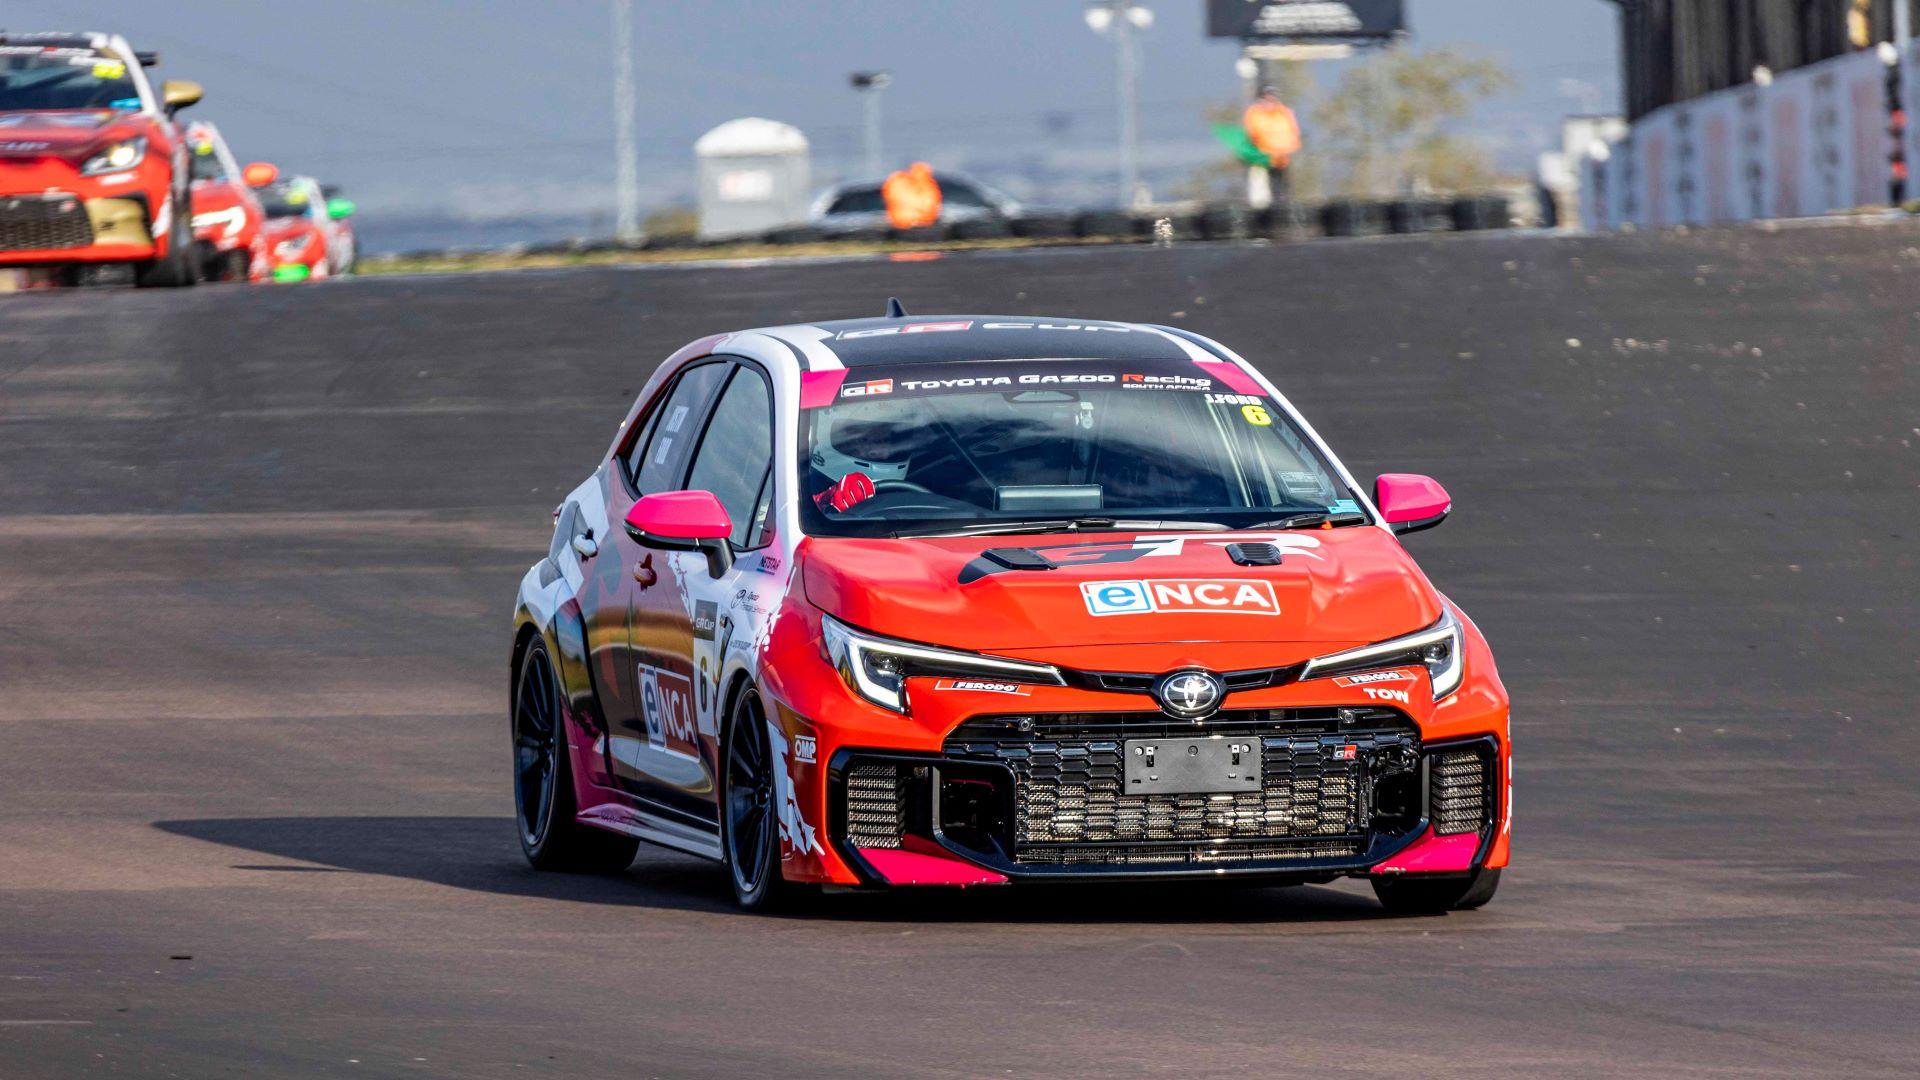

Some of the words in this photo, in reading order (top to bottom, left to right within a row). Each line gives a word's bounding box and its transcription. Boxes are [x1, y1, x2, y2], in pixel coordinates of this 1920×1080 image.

[842, 380, 892, 396] GR
[901, 376, 1012, 390] TOYOTA
[1019, 374, 1116, 384] GAZOO
[1122, 374, 1211, 387] Racing
[1241, 405, 1272, 426] 6
[700, 656, 708, 713] 6
[956, 682, 1016, 692] FERODO
[1363, 688, 1409, 704] TOW
[795, 739, 816, 759] OMP
[1334, 745, 1357, 760] GR
